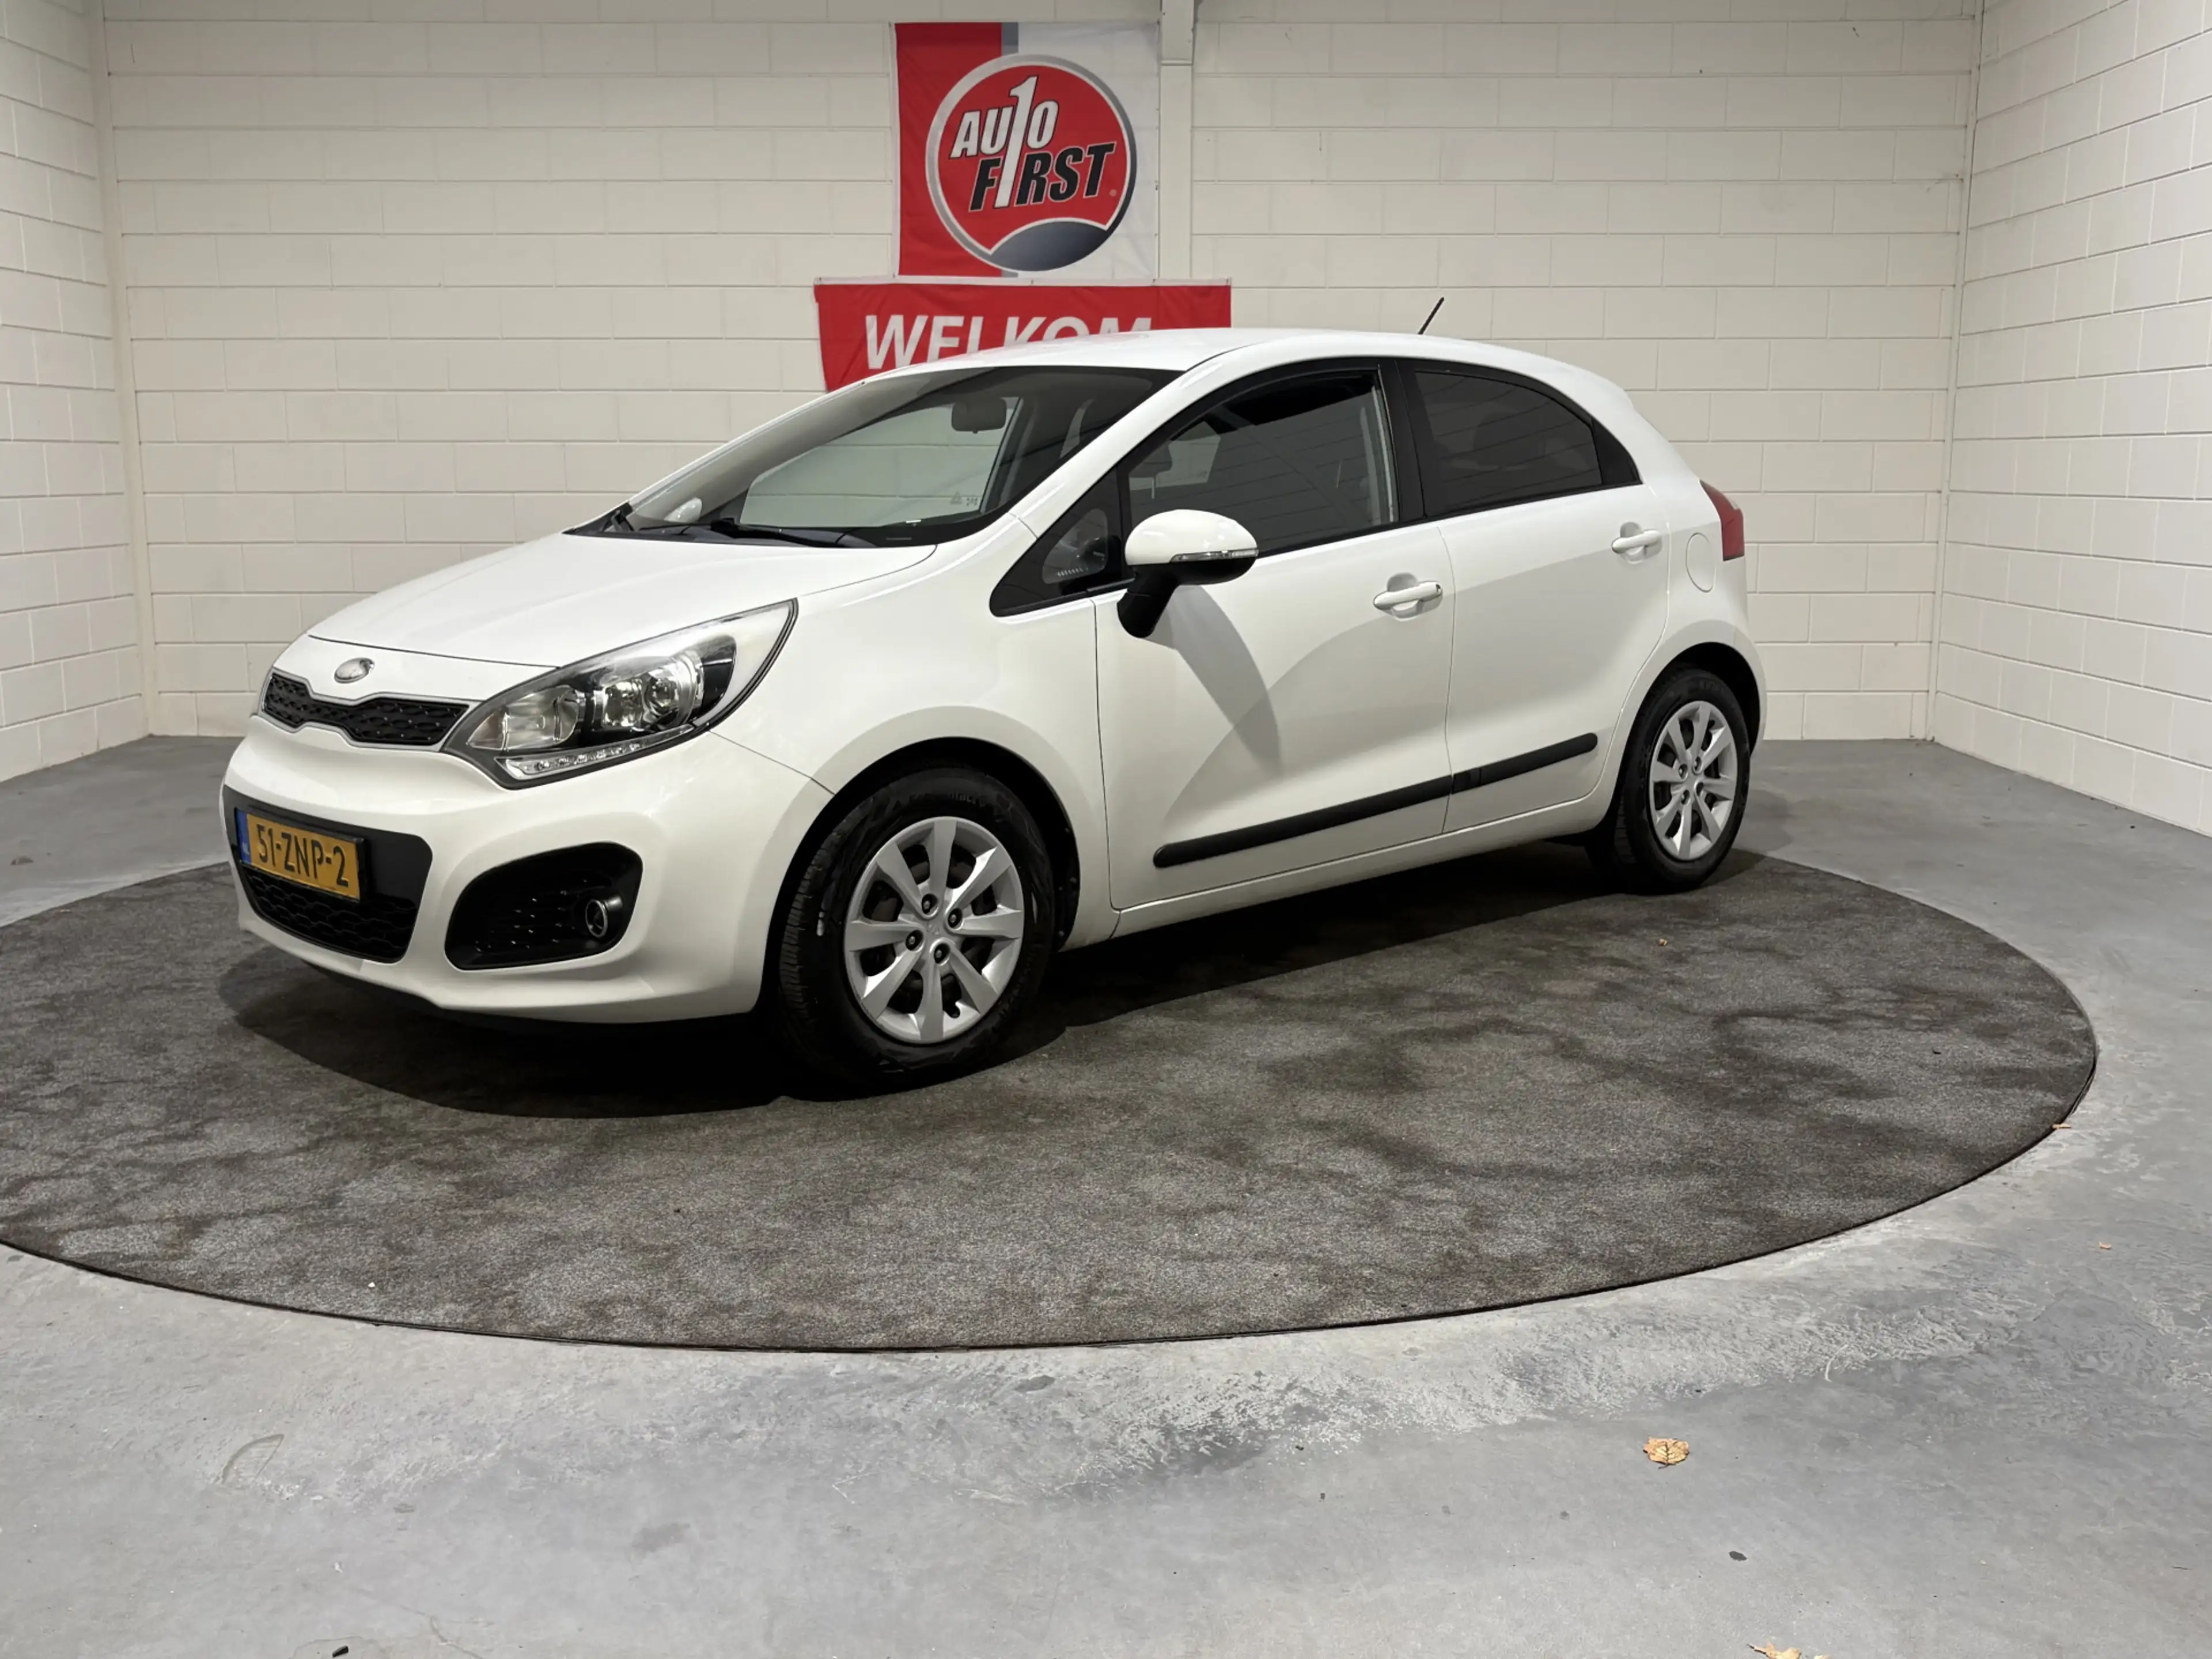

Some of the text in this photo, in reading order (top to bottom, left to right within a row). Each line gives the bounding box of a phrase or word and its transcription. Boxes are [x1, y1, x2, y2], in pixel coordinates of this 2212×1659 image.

[968, 141, 1117, 213] FIRST
[865, 315, 1152, 370] WELK
[256, 823, 349, 888] 51-ZNP-2
